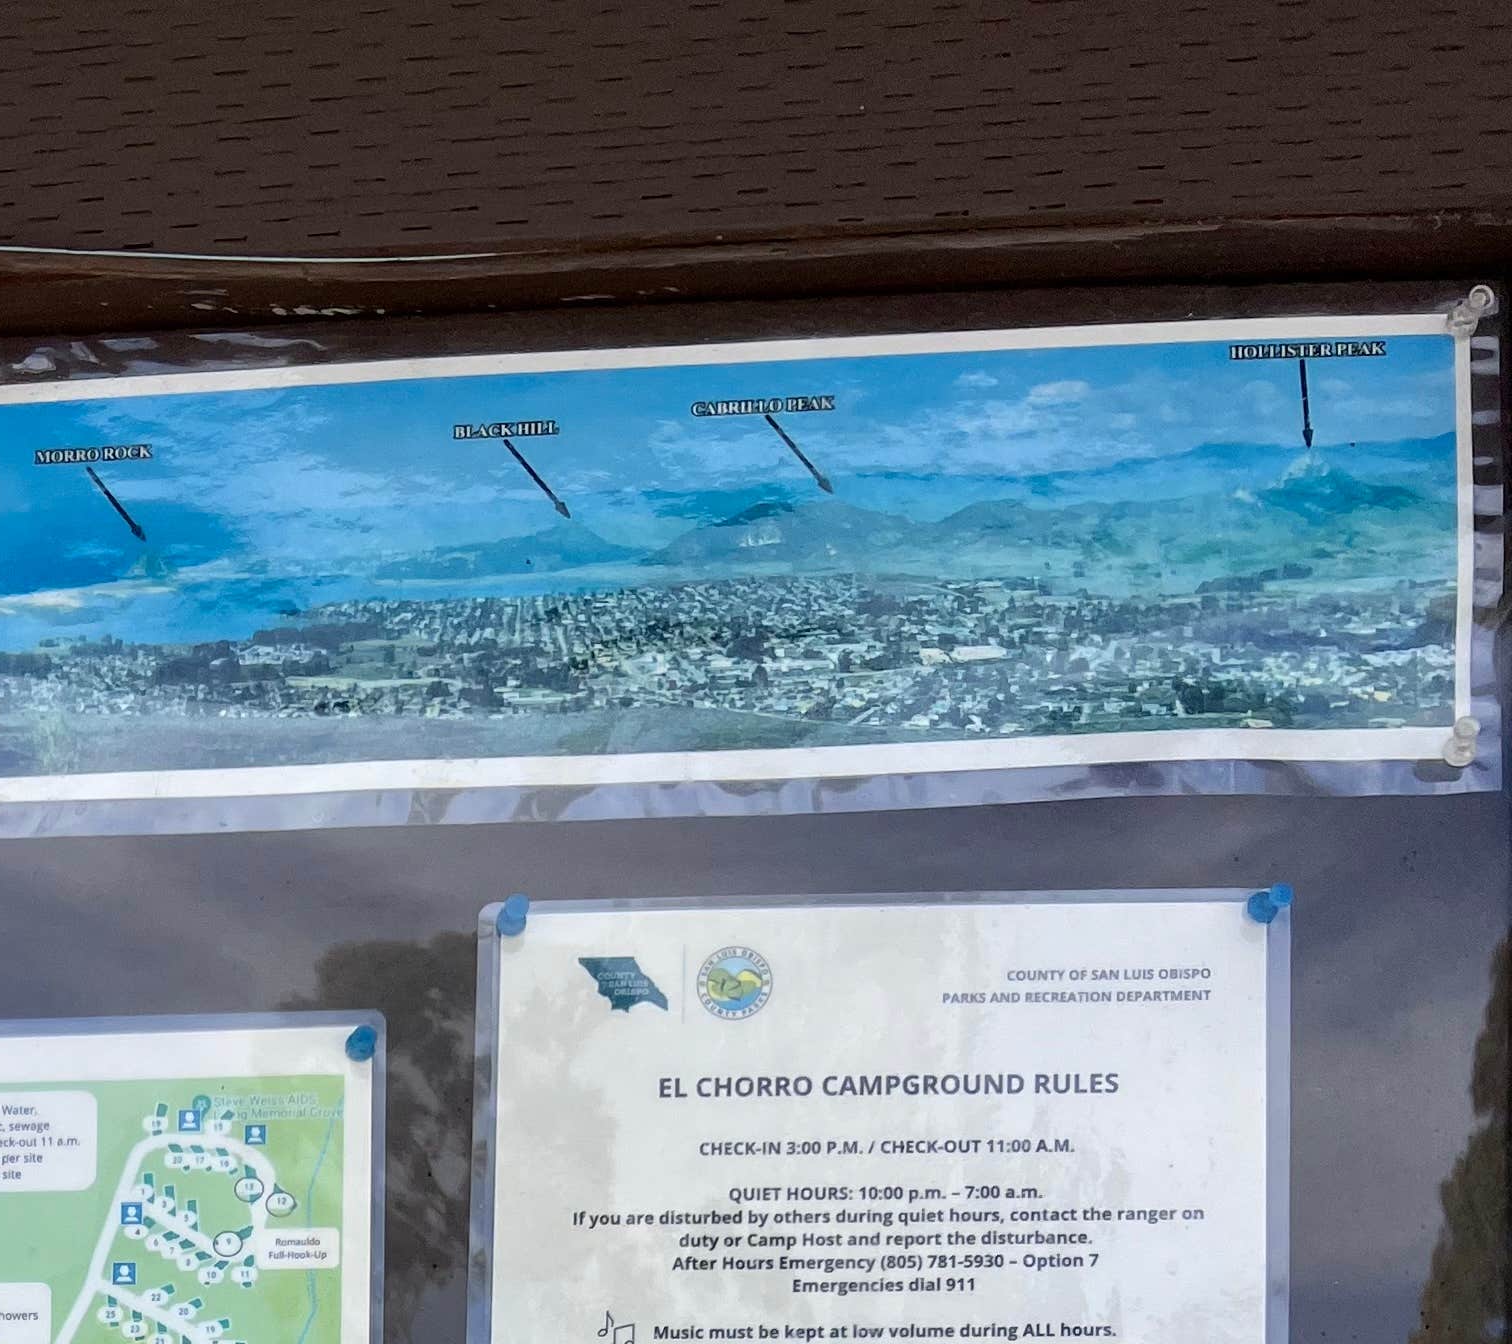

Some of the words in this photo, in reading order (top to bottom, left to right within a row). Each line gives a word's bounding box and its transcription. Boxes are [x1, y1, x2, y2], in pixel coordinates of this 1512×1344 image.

[1229, 344, 1332, 360] HOLLISTER
[1335, 341, 1386, 356] PEAK
[786, 395, 835, 412] PEAK
[453, 424, 514, 440] BLACK
[517, 420, 560, 436] HILL
[35, 449, 100, 464] MORRO
[103, 444, 152, 461] ROCK
[659, 1077, 688, 1098] EL
[696, 1075, 813, 1098] CHORRO
[822, 1073, 1025, 1097] CAMPGROUND
[1034, 1073, 1119, 1094] RULES
[2, 1170, 22, 1180] site
[268, 1250, 328, 1261] Full-Hook-Up
[792, 1277, 904, 1297] Emergencies
[908, 1277, 941, 1292] dial
[946, 1277, 975, 1292] 911
